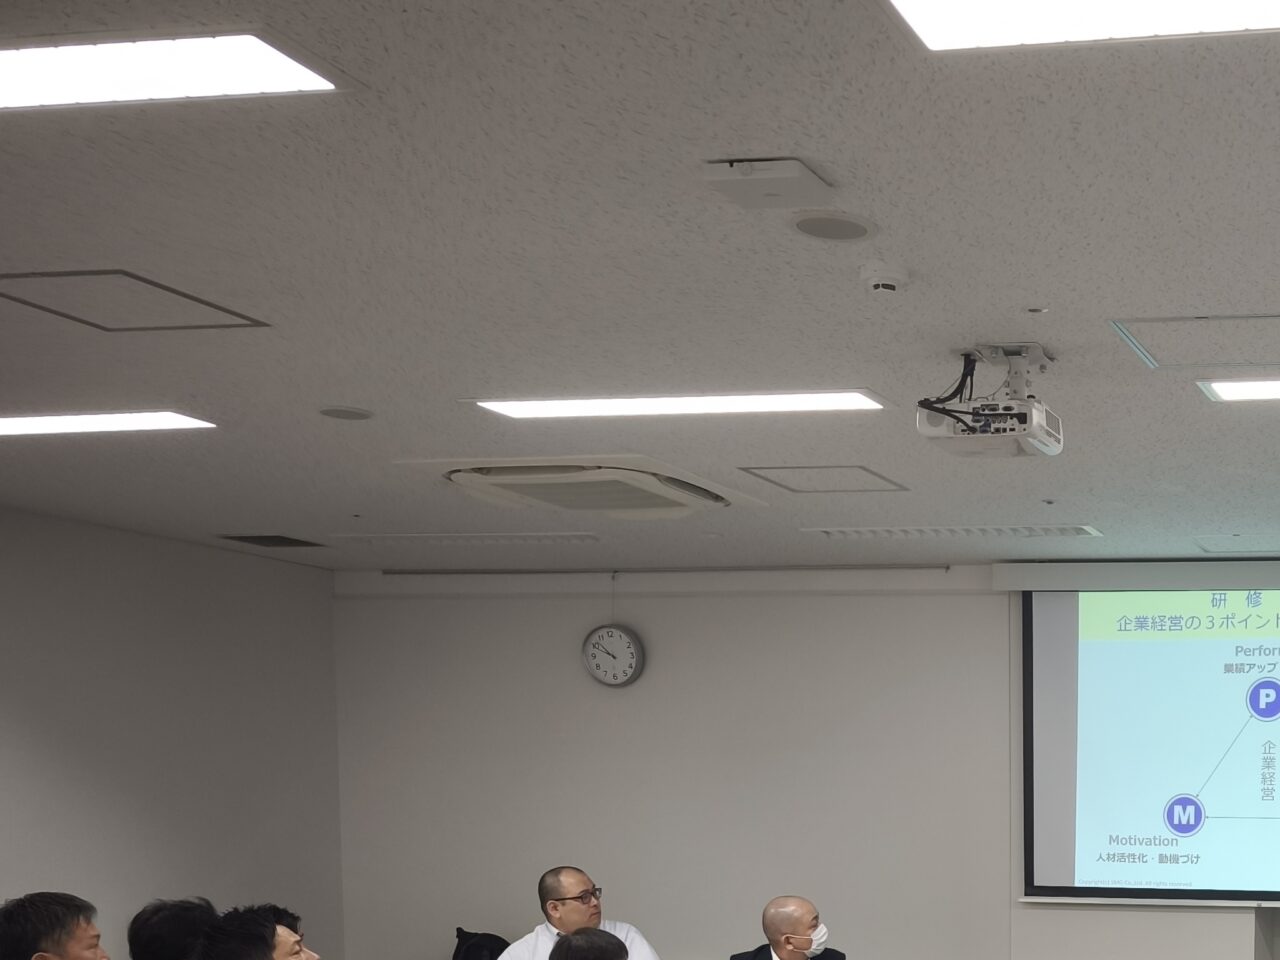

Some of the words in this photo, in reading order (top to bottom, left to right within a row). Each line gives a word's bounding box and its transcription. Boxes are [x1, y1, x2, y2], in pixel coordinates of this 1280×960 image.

[1259, 688, 1277, 709] P
[1260, 739, 1277, 802] 企業経営
[1173, 805, 1196, 825] M
[1108, 833, 1179, 848] Motivation
